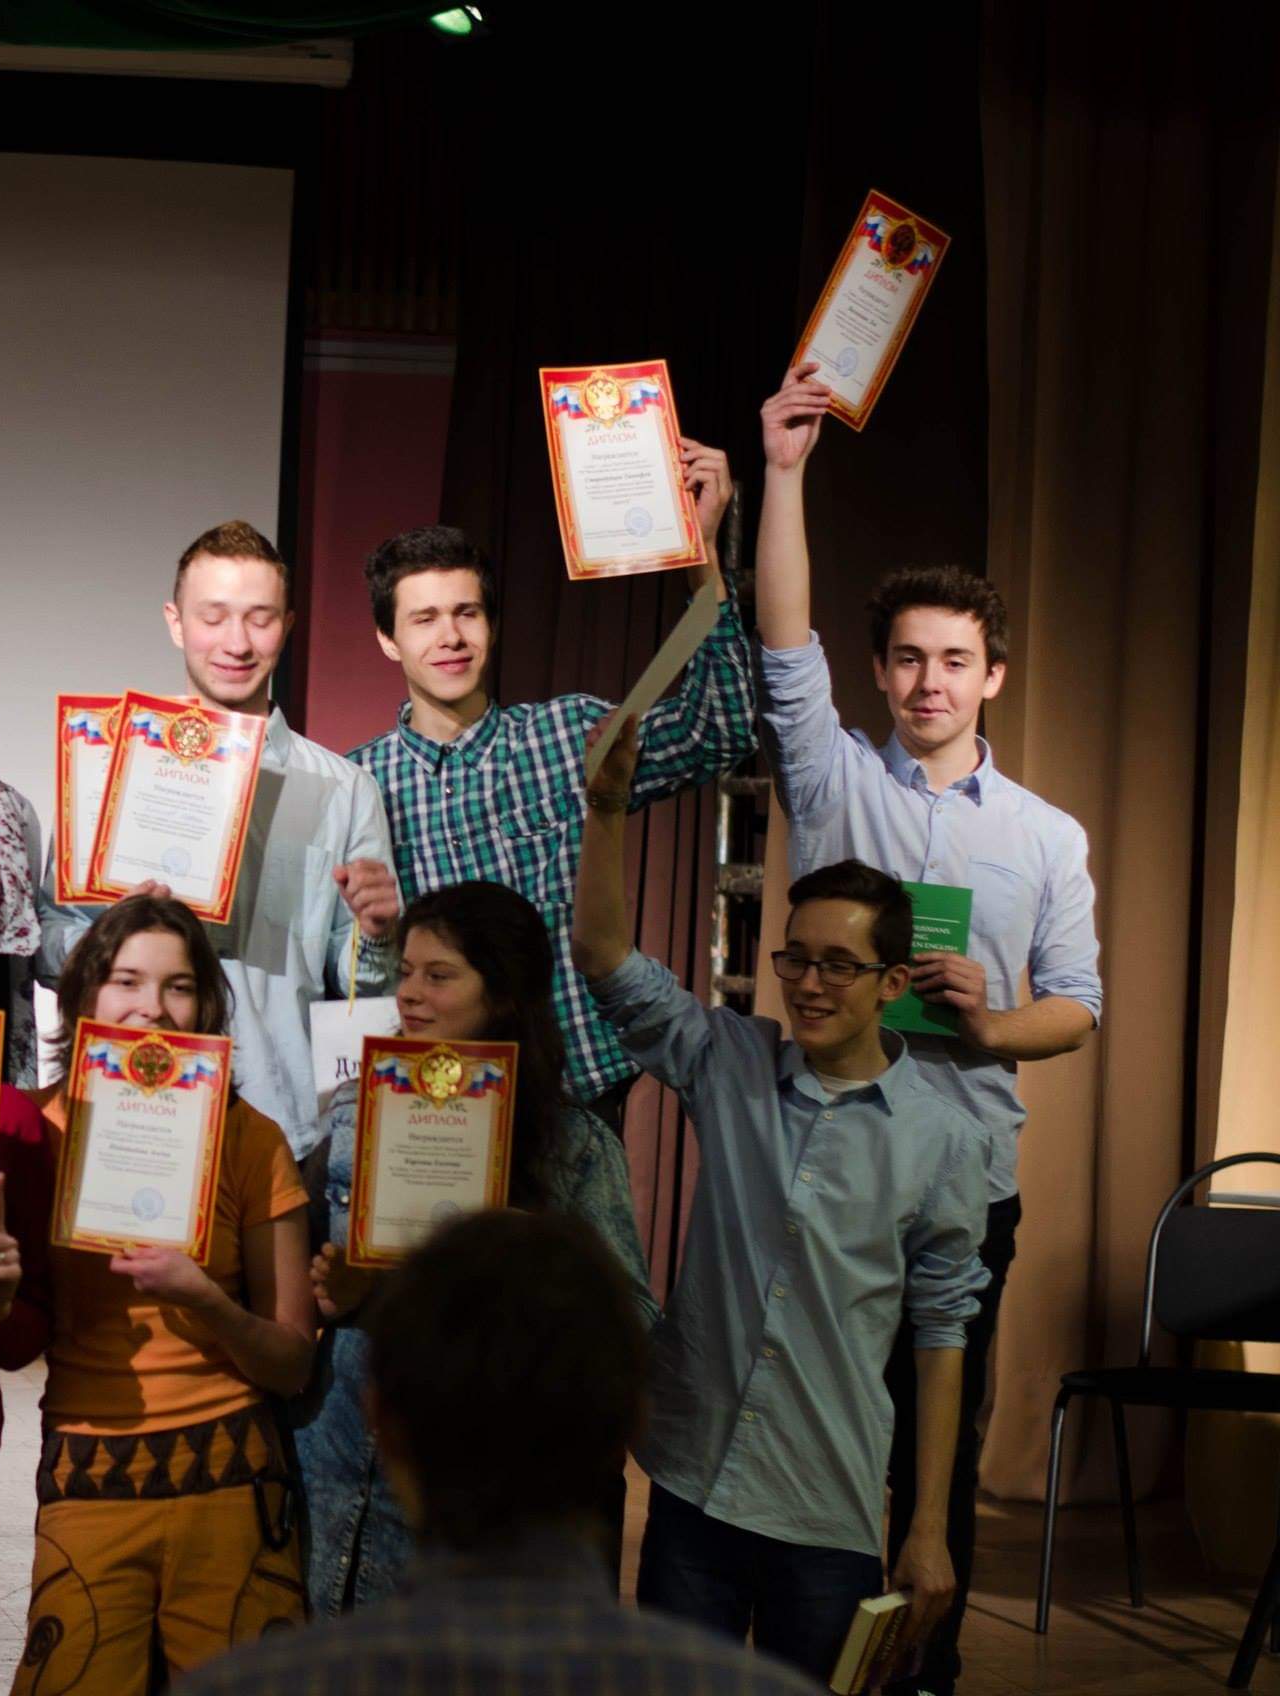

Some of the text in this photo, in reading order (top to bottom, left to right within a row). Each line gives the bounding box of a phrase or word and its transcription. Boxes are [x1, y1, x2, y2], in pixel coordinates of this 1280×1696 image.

[154, 768, 210, 785] ДИПЛОМ
[116, 1101, 177, 1117] ДИПЛОМ
[407, 1113, 468, 1128] ДИПЛОМ
